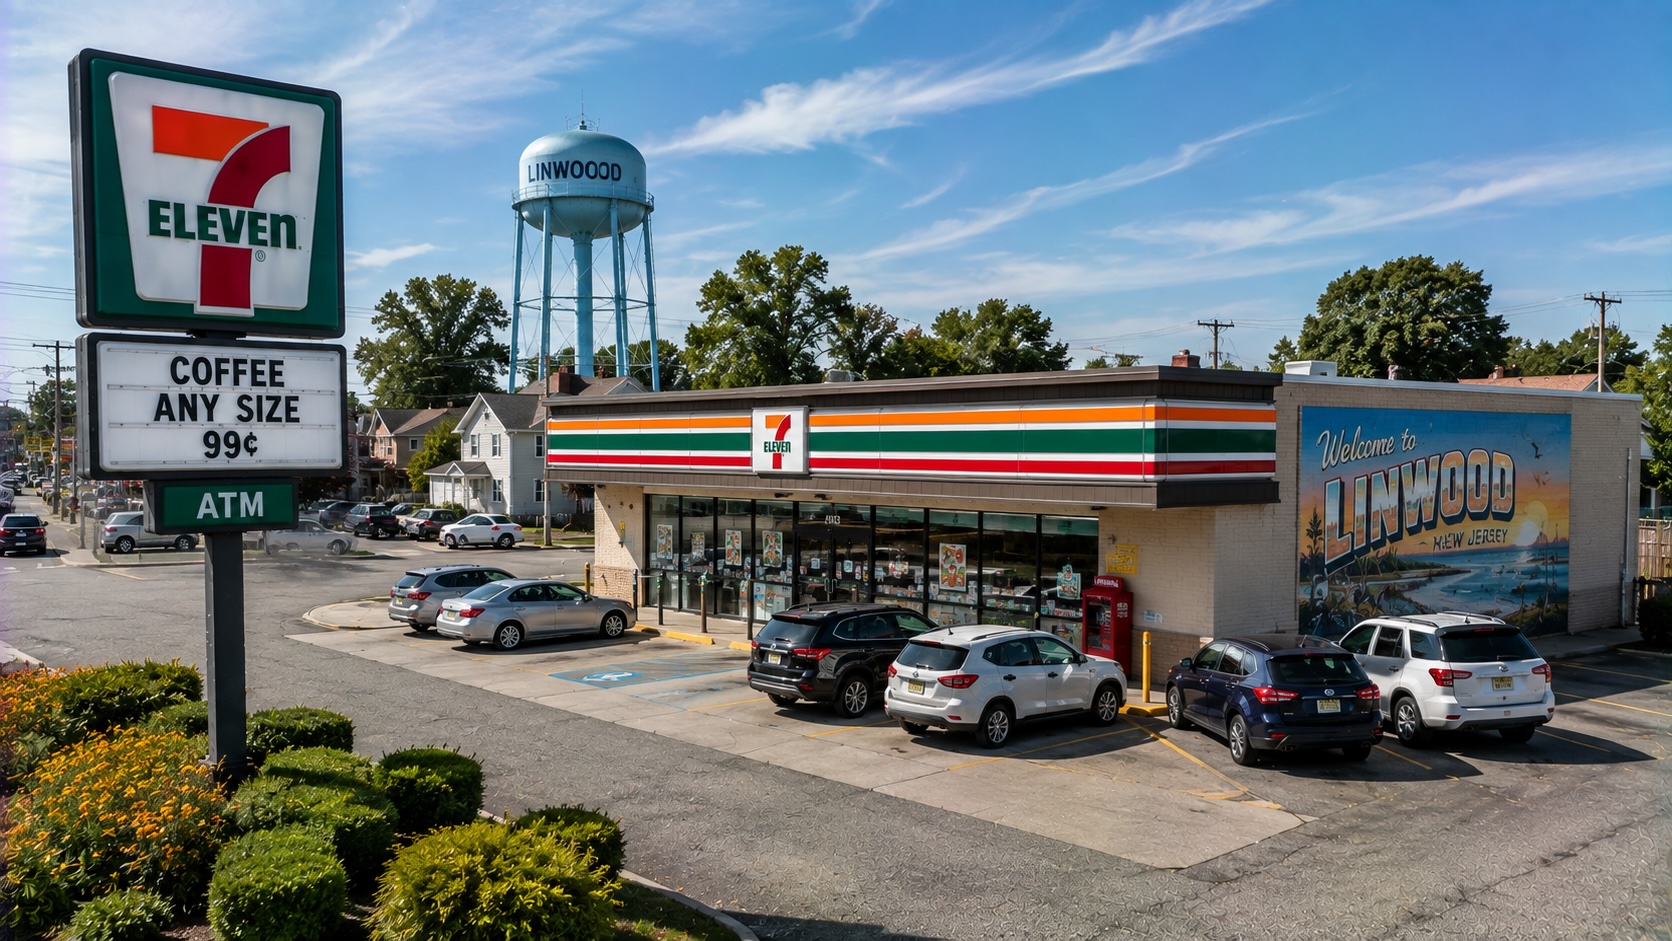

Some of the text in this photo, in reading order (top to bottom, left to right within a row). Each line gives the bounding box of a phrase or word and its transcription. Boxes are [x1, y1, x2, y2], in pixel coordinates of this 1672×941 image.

[528, 160, 622, 183] LINWOOOD
[152, 104, 292, 309] 7
[170, 355, 285, 388] COFFEE
[154, 394, 300, 423] ANY SIZE
[203, 430, 258, 459] 99¢
[765, 414, 791, 469] 7
[1316, 425, 1417, 470] Welcome to
[196, 491, 264, 519] ATM
[1324, 448, 1516, 576] LINWOOD
